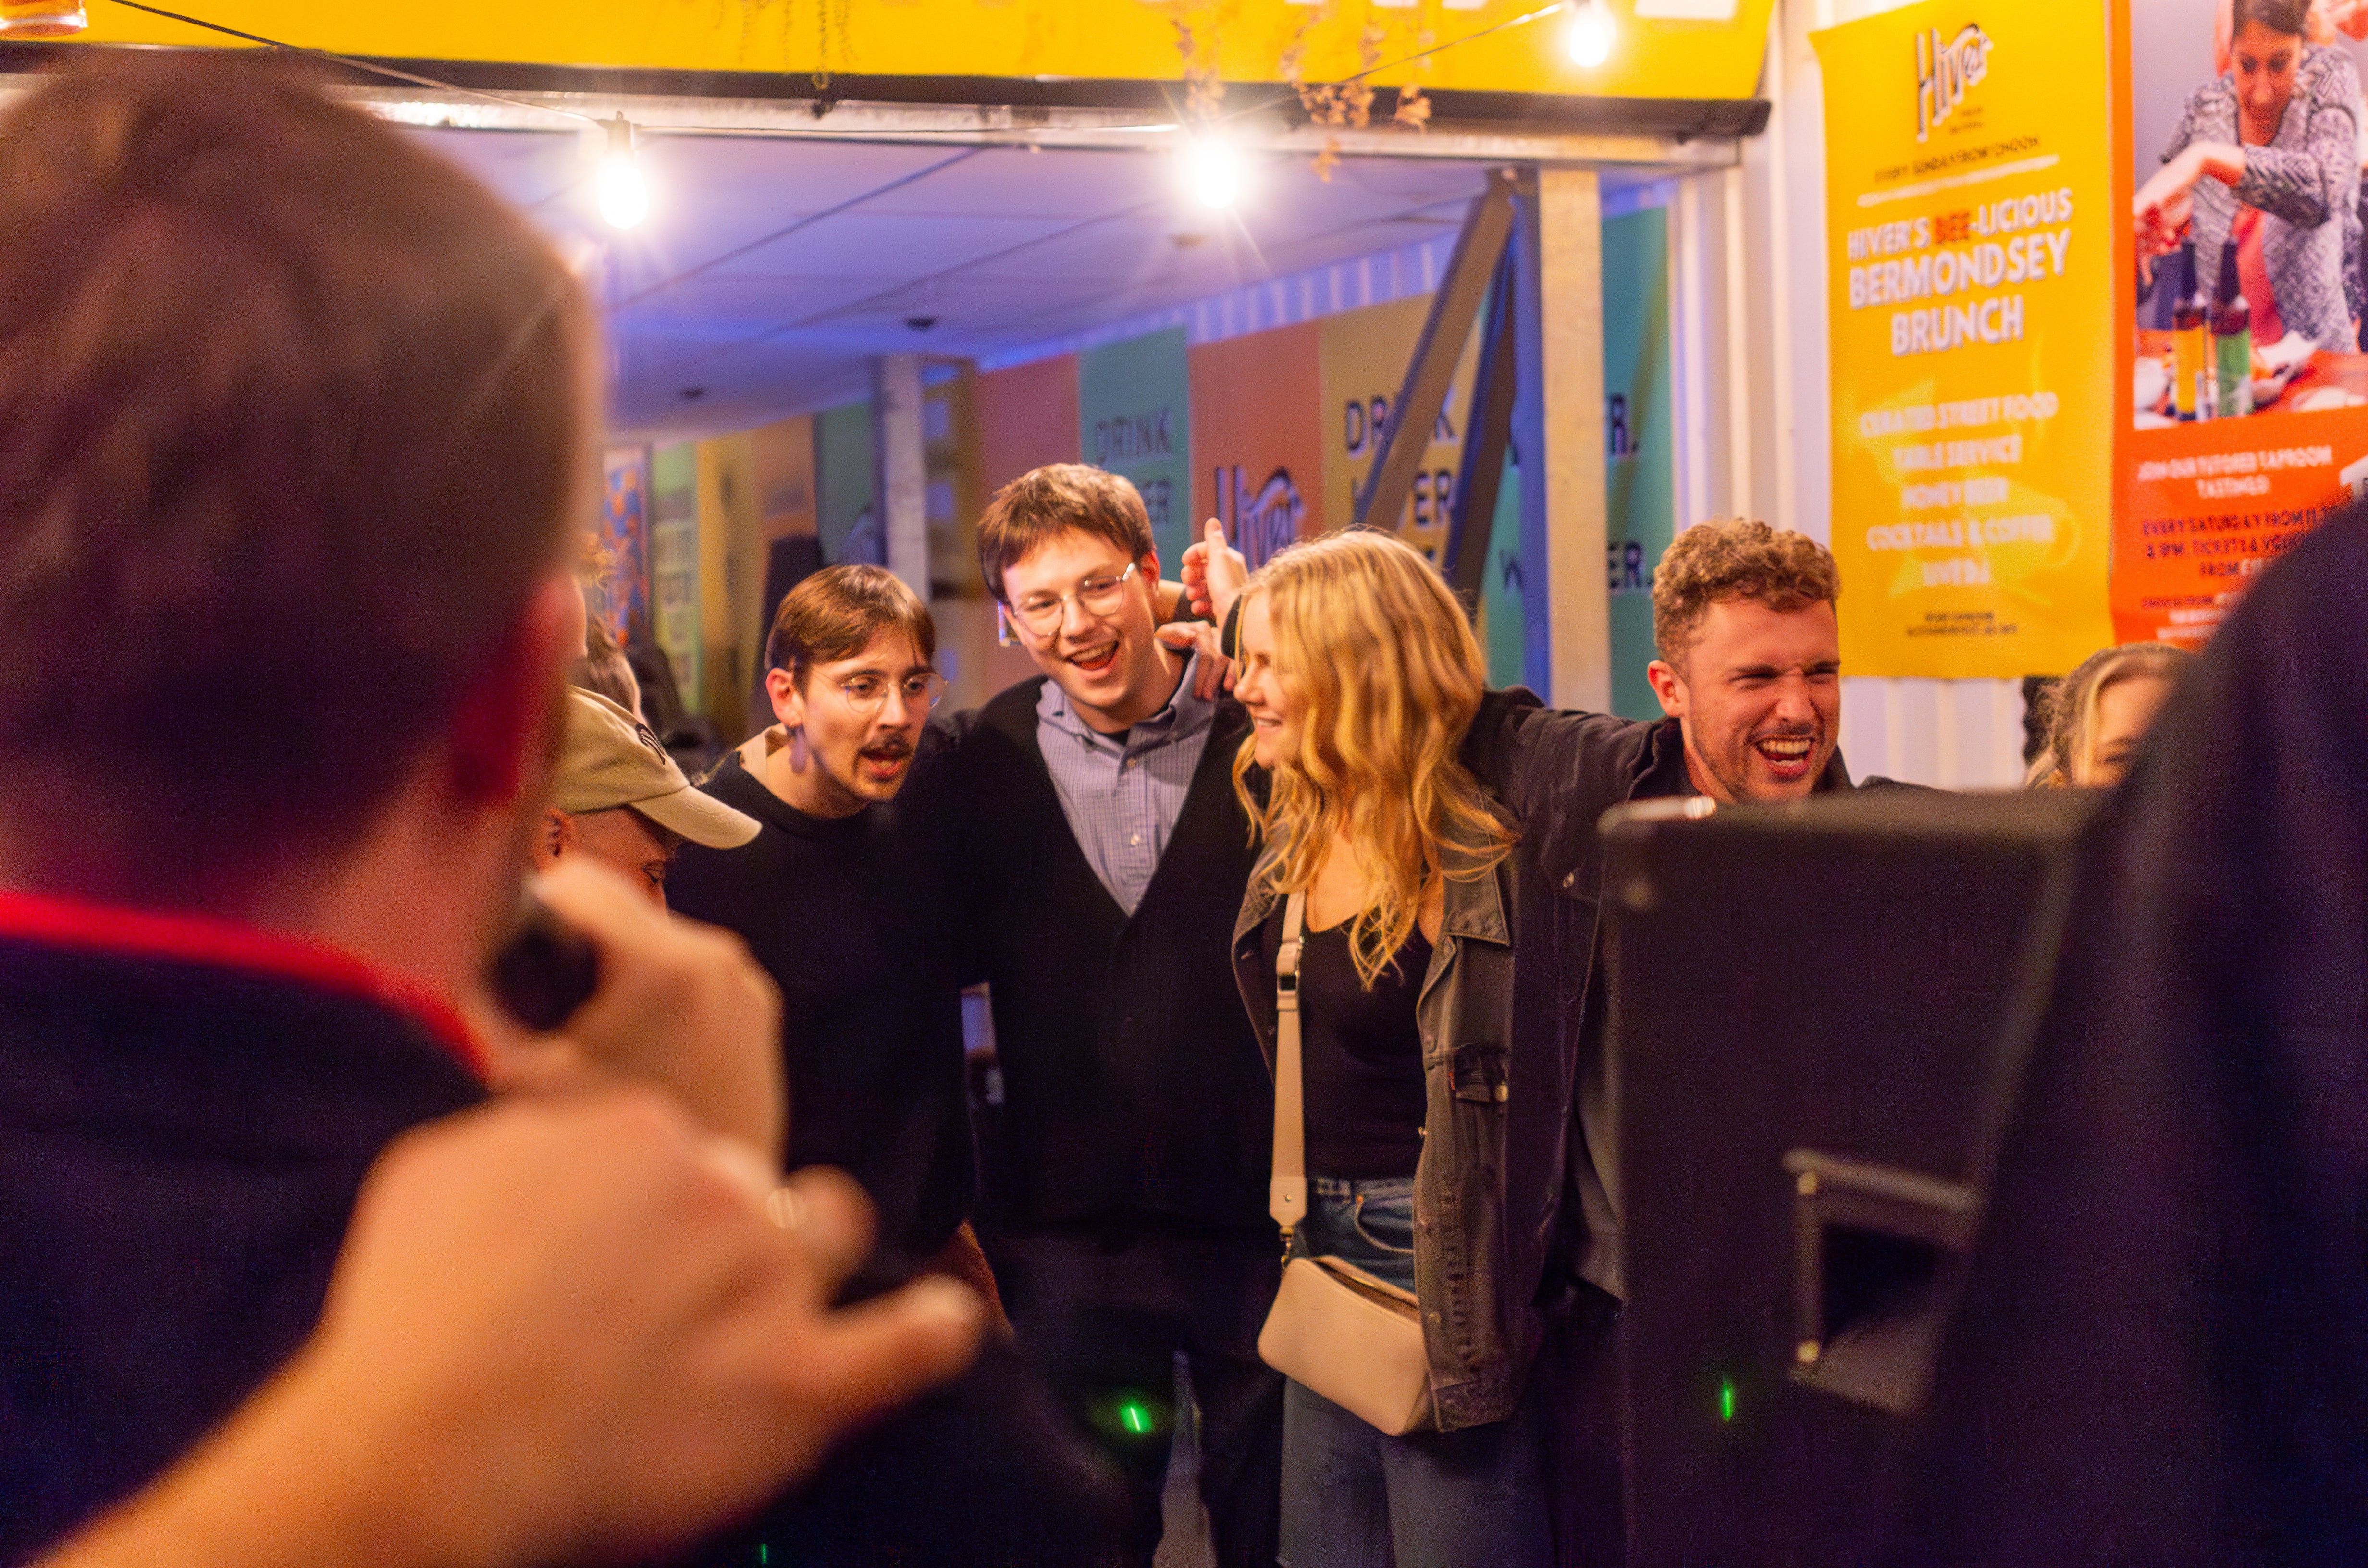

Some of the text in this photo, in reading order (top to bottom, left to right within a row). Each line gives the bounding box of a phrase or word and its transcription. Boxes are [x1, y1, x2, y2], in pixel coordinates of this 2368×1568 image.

[1848, 217, 1930, 261] HIVER'S
[1849, 229, 2072, 310] BERMONDSEY
[1891, 294, 2024, 357] BRUNCH
[1937, 397, 2000, 430] STREET
[2002, 391, 2060, 421] FOOD
[1946, 433, 2023, 468] SERVICE
[1866, 519, 1963, 552] COCKTAILS
[2142, 517, 2185, 537] EVERY
[2188, 513, 2261, 532] SATURDAY
[2264, 509, 2304, 527] FROM
[2193, 536, 2246, 555] TICKETS
[2199, 561, 2239, 576] FROM
